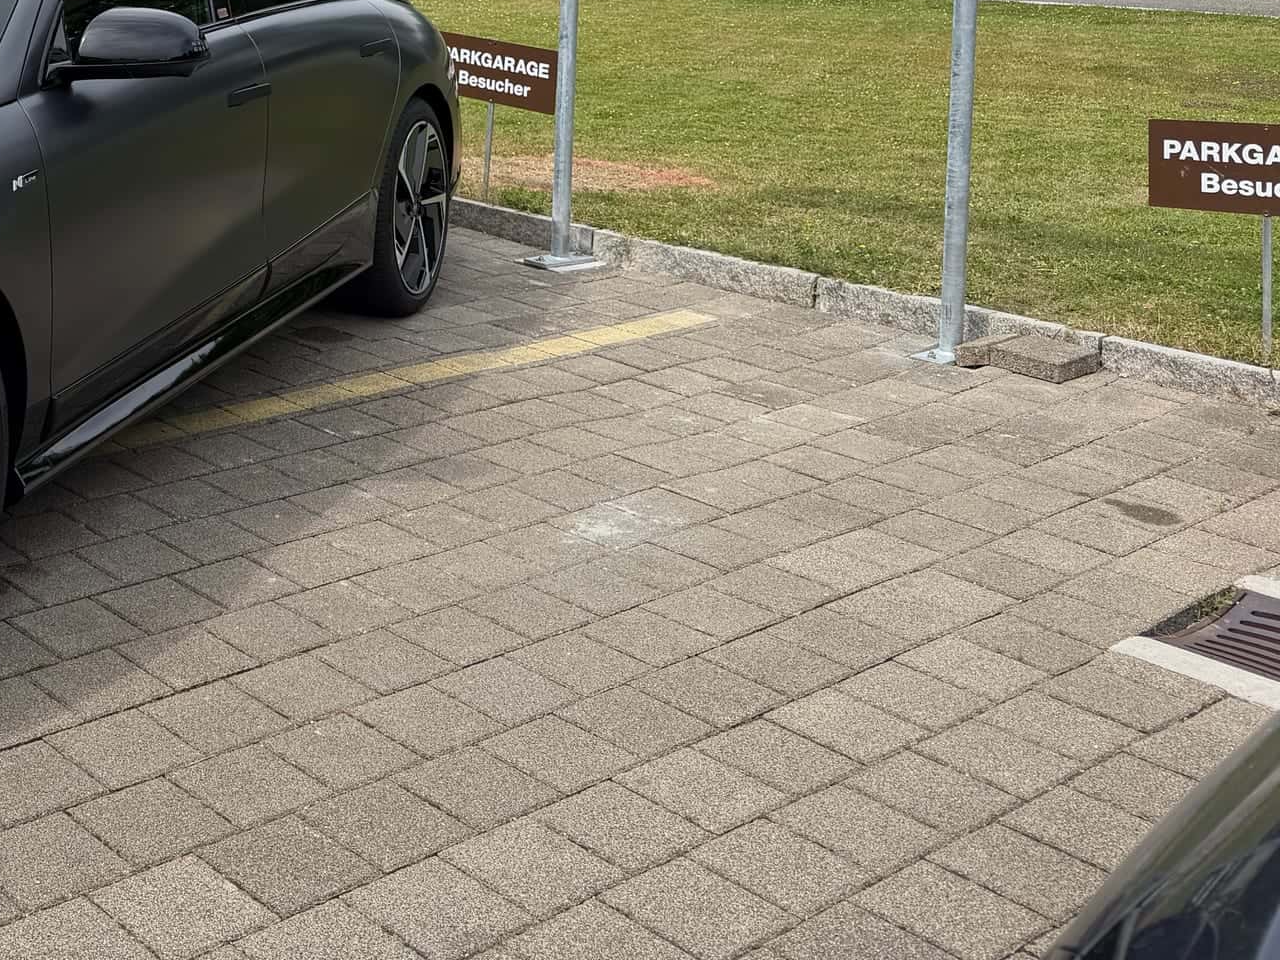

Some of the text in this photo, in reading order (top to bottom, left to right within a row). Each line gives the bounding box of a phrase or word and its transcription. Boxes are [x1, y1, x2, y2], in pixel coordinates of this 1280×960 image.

[447, 46, 550, 79] ARKGARAGE
[458, 69, 531, 97] Besucher
[1163, 139, 1280, 166] PARKGA
